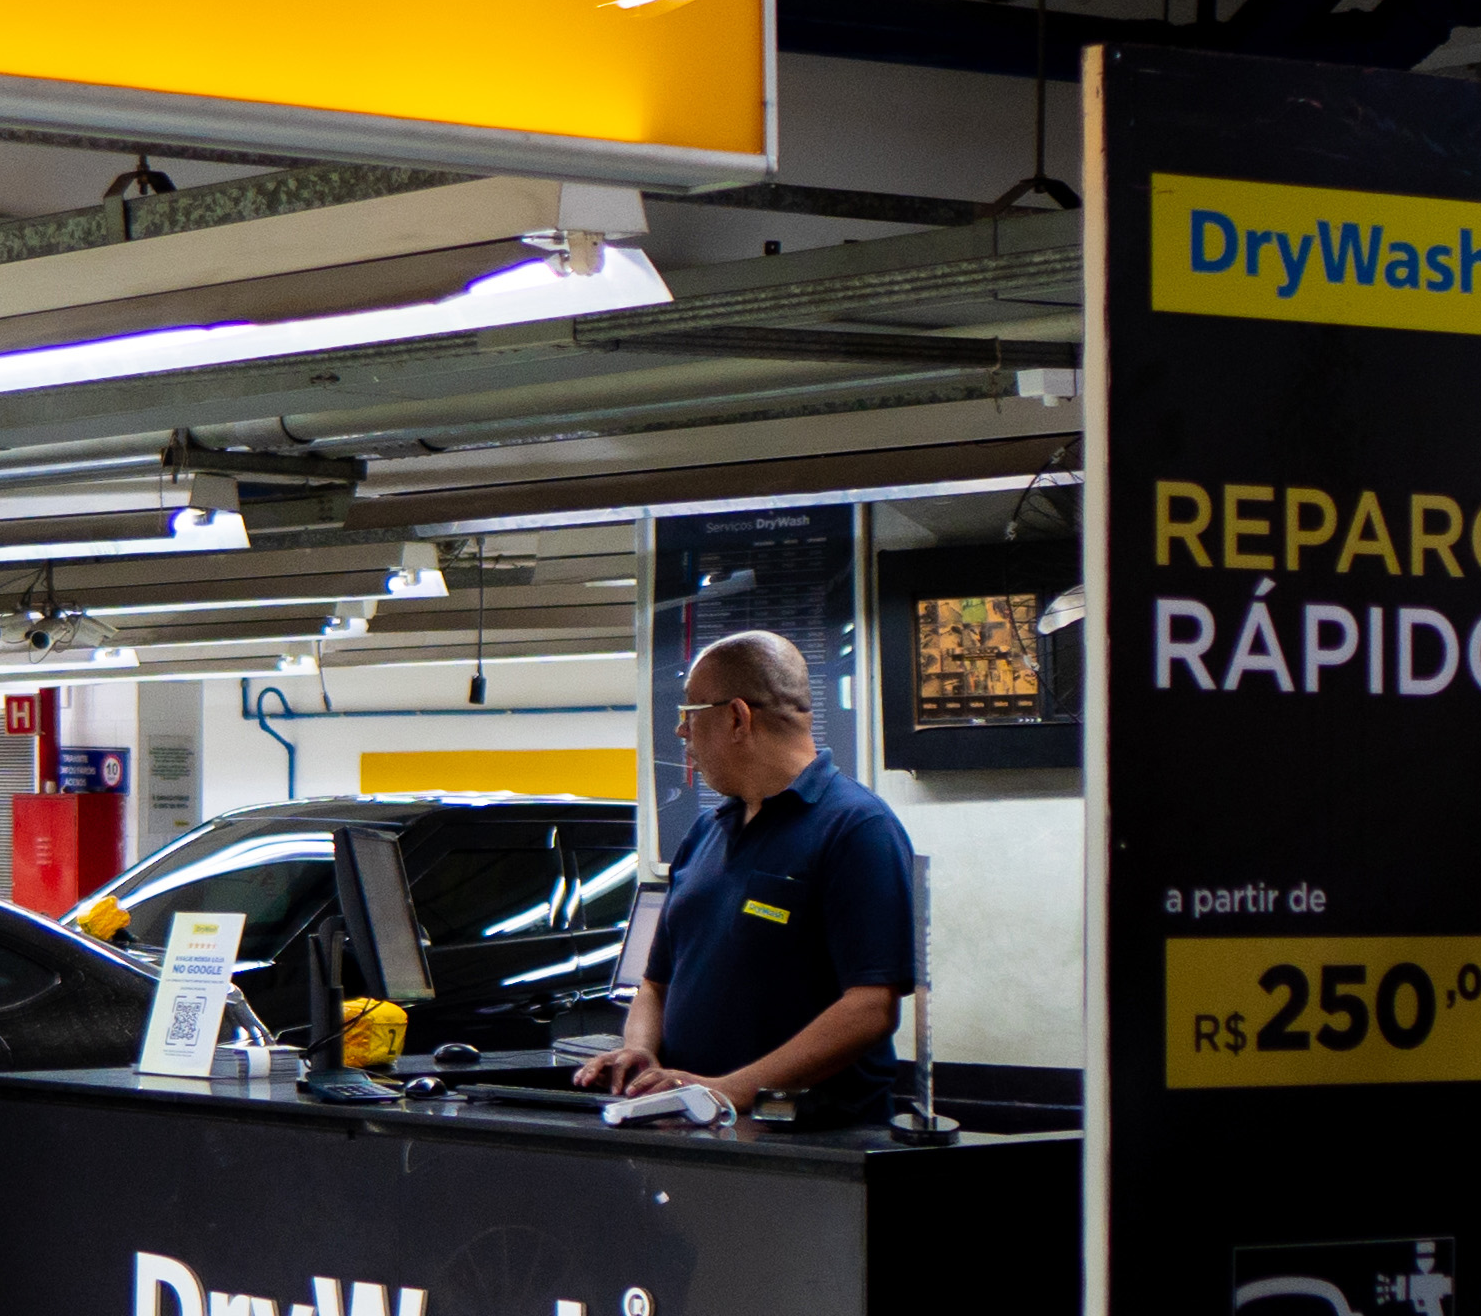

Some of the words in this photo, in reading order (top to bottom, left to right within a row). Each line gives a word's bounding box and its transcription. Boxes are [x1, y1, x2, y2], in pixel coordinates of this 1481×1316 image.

[755, 515, 811, 531] DryWash
[10, 700, 31, 730] H
[105, 762, 119, 776] 10
[1165, 888, 1183, 913] a
[1193, 882, 1280, 919] partir
[1288, 882, 1327, 914] de
[172, 964, 186, 974] NO
[187, 965, 223, 975] GOOGLE
[387, 1029, 397, 1056] 2
